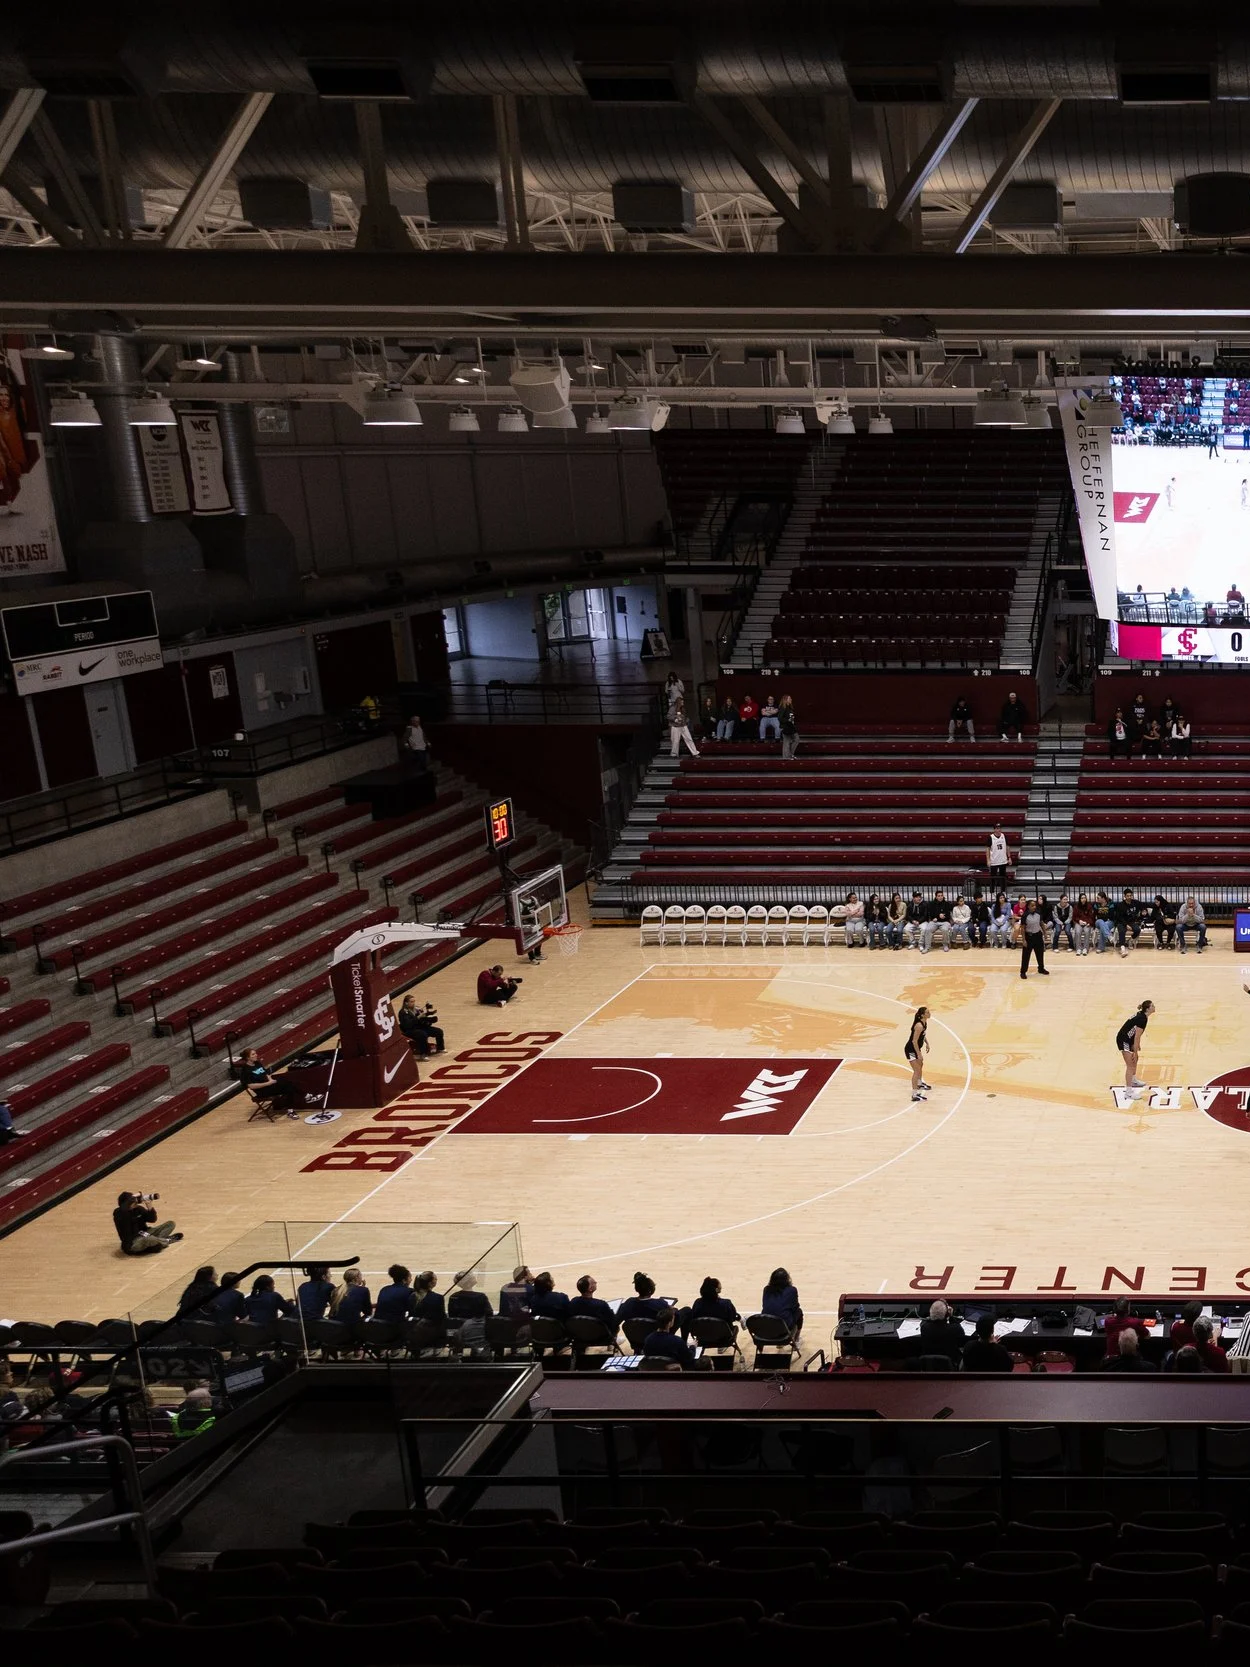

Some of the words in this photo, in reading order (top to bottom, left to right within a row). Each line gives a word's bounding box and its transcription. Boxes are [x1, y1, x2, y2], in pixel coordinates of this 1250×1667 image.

[1077, 424, 1093, 499] GROUP
[1088, 426, 1110, 551] HEFFERNAN
[16, 543, 48, 562] NASH
[73, 631, 94, 642] PERIOD
[1231, 632, 1242, 652] 0
[118, 650, 133, 658] one
[119, 652, 161, 667] workplace
[212, 749, 230, 758] 107
[493, 817, 508, 842] 30
[350, 962, 366, 1029] TicketSmarter
[298, 1031, 564, 1173] BRONCOS
